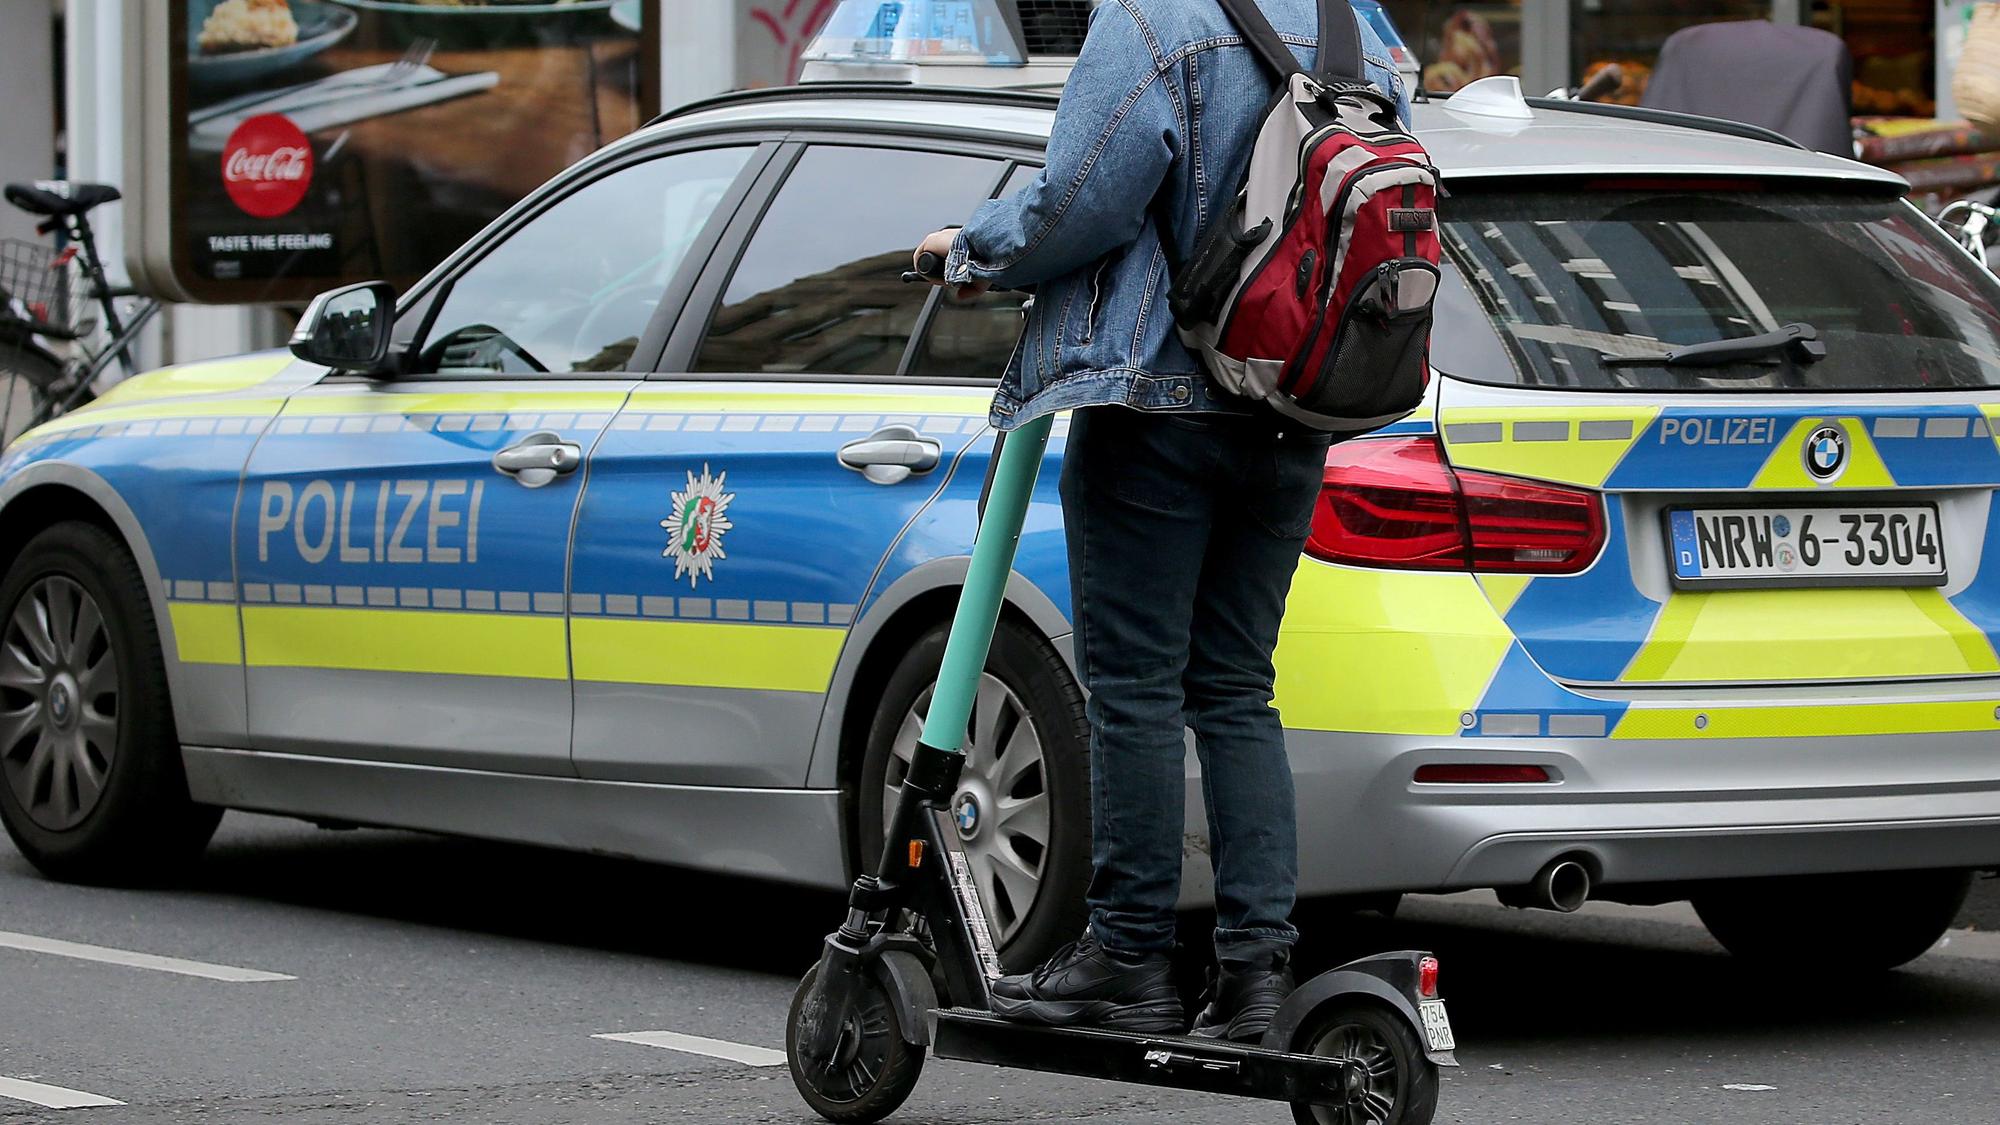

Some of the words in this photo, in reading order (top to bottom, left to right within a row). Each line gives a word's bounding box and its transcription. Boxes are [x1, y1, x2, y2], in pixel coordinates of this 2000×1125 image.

[208, 235, 249, 251] TASTE
[250, 235, 276, 250] THE
[277, 233, 332, 249] FEELING
[1660, 418, 1776, 445] POLIZEI
[258, 479, 485, 564] POLIZEI
[1696, 515, 1774, 569] NRW
[1799, 513, 1937, 567] 6-3304
[1681, 551, 1694, 566] D
[1422, 1005, 1446, 1024] 754
[1428, 1026, 1453, 1046] PNR
